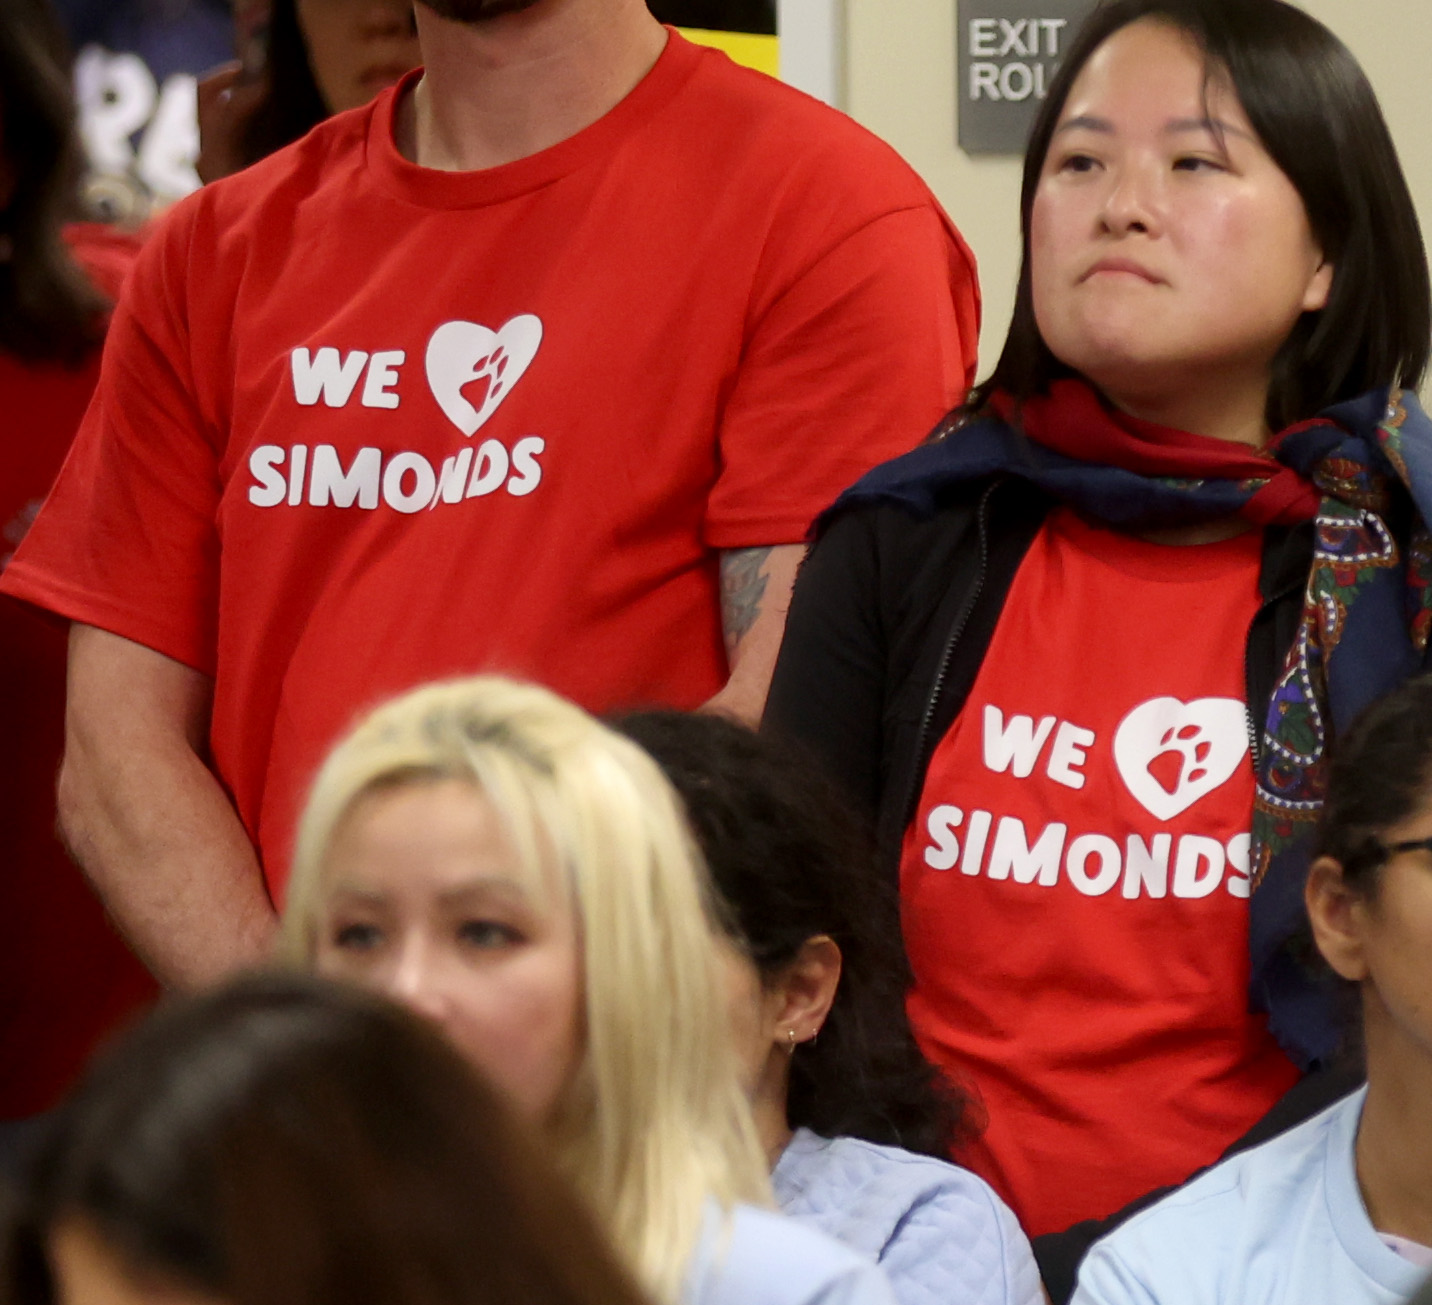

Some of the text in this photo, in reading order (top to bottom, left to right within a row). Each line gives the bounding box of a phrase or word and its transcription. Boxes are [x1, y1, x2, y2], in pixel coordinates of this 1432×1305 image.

[969, 18, 1067, 57] EXIT
[291, 347, 406, 409] WE
[248, 436, 545, 514] SIMONDS
[984, 704, 1095, 790] WE
[924, 804, 1252, 899] SIMONDS
